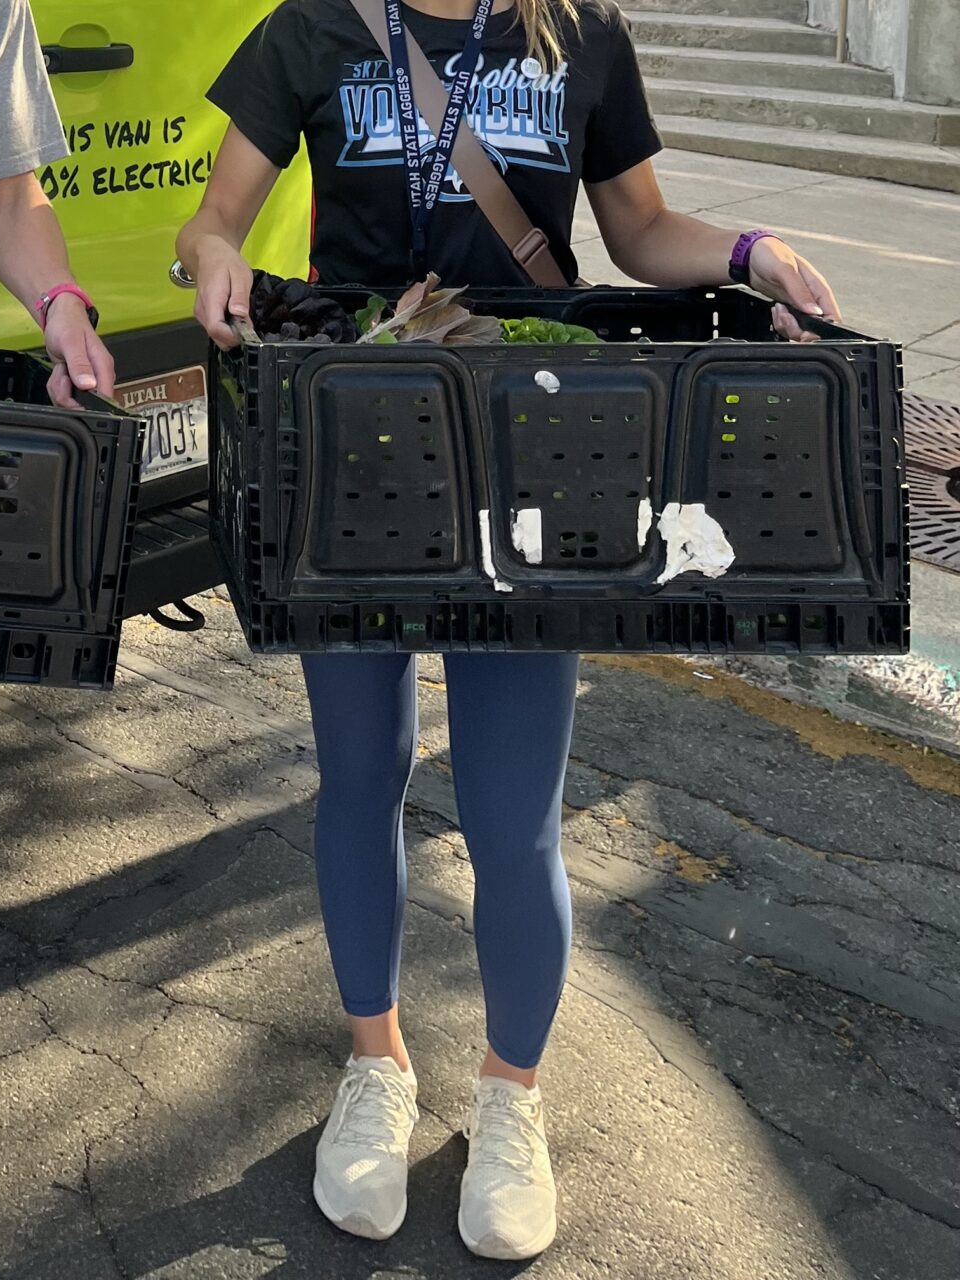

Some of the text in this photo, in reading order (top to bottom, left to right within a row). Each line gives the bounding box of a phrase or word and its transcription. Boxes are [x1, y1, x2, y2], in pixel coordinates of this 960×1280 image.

[387, 2, 402, 36] UTAH
[352, 62, 382, 79] SKY
[450, 71, 471, 104] UTAH
[104, 119, 151, 149] VAN
[163, 116, 186, 144] IS
[438, 106, 460, 149] STATE
[403, 124, 419, 168] STATE
[39, 150, 212, 201] 0% ELECTRIC!
[408, 172, 422, 208] UTAH
[123, 384, 167, 408] UTAH
[403, 623, 426, 631] IFCO
